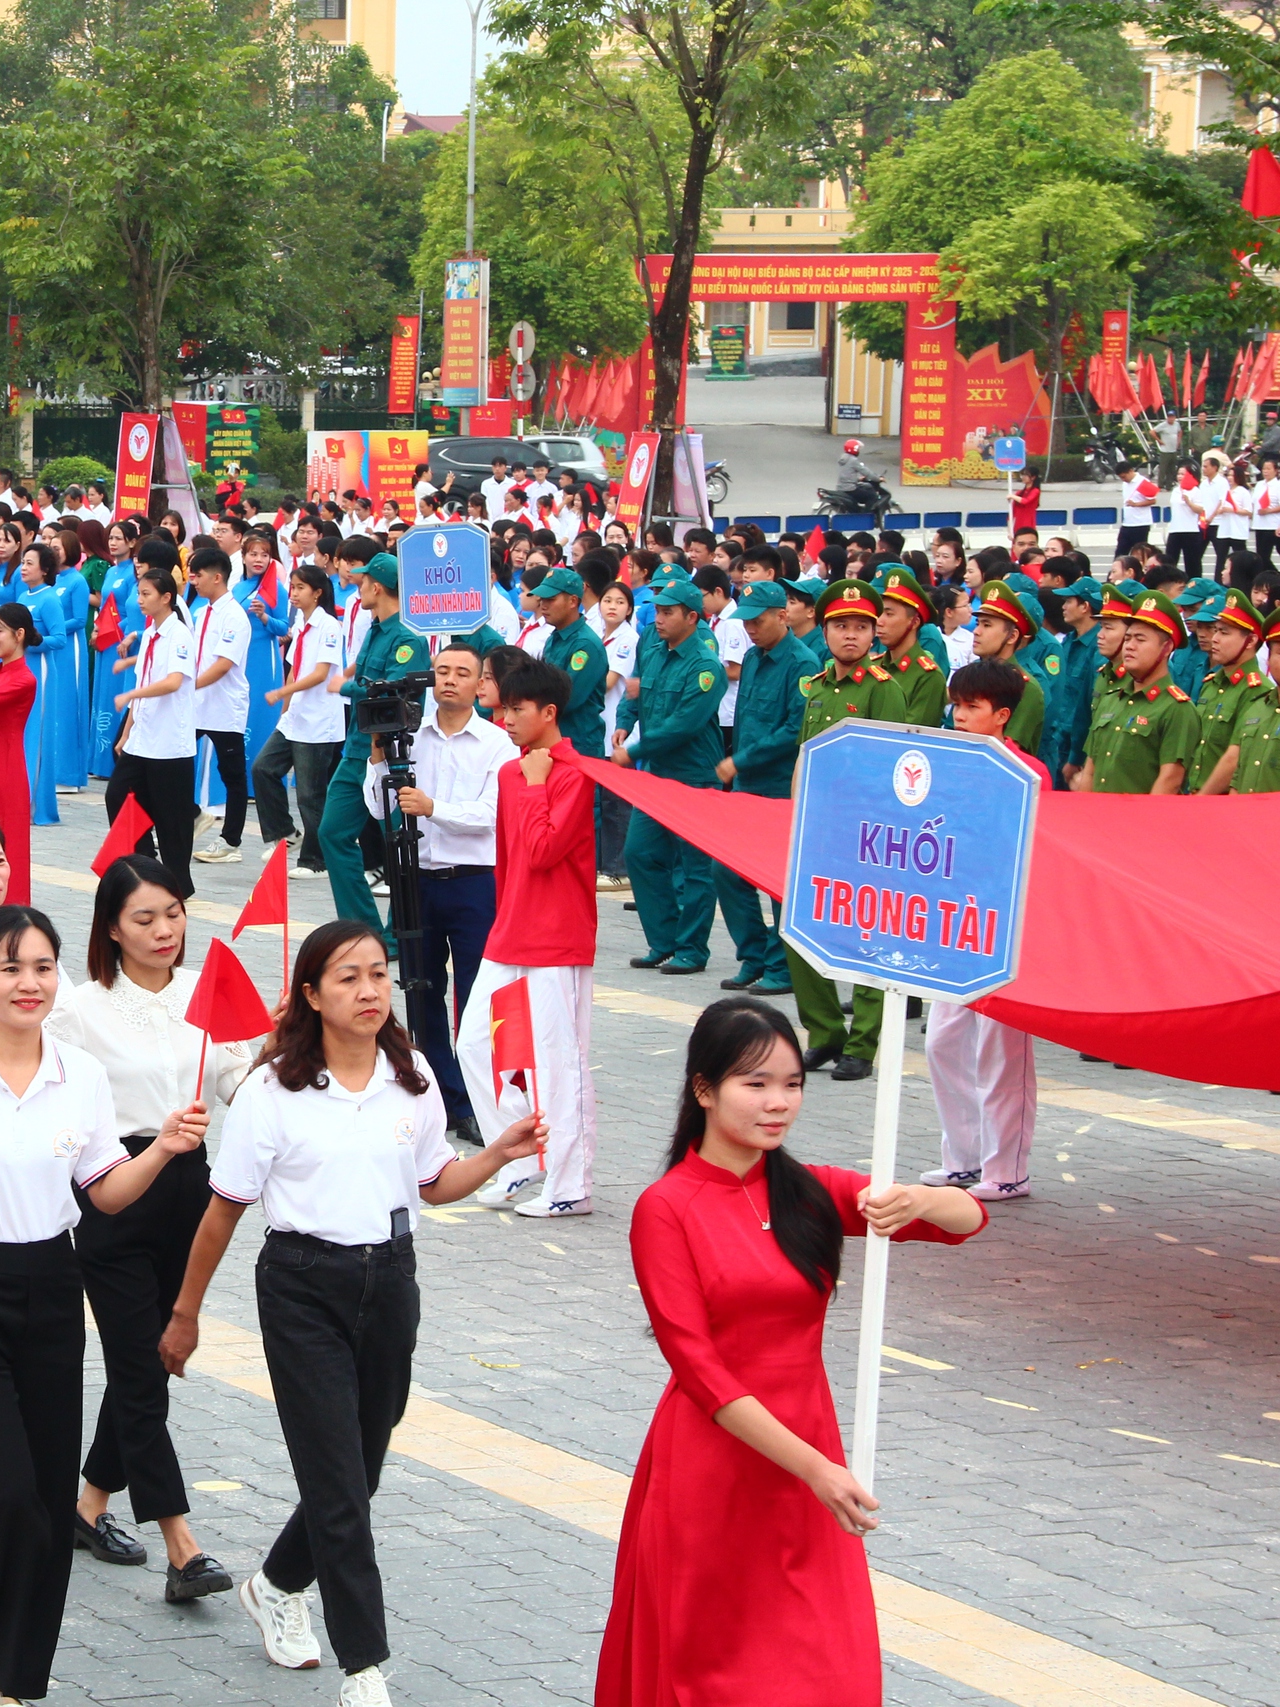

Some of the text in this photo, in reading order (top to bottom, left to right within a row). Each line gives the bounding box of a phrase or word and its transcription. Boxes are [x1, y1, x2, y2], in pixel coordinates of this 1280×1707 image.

[711, 266, 725, 280] ĐẠI
[727, 265, 741, 280] HỘI
[743, 266, 756, 280] ĐẠI
[758, 264, 776, 278] BIỂU
[778, 264, 801, 278] ĐẢNG
[802, 265, 814, 280] BỘ
[815, 264, 831, 278] CÁC
[833, 264, 849, 278] CẤP
[852, 265, 878, 279] NHIỆM
[892, 266, 912, 277] 2025
[692, 283, 706, 296] ĐẠI
[708, 280, 726, 294] BIỂU
[728, 281, 749, 294] TOÀN
[751, 281, 772, 295] QUỐC
[774, 281, 790, 294] LẦN
[792, 282, 807, 294] THỨ
[809, 284, 822, 294] XIV
[824, 281, 840, 294] CỦA
[841, 281, 864, 294] ĐẢNG
[866, 282, 888, 296] CỘNG
[890, 280, 907, 294] SẢN
[909, 281, 926, 295] VIỆT
[920, 341, 940, 354] TẤT CẢ
[911, 360, 947, 372] VÌ MỤC TIÊU
[914, 376, 928, 387] DÂN
[987, 378, 1004, 386] HỘI
[966, 388, 1008, 401] XIV
[914, 408, 941, 419] DÂN CHỦ
[909, 424, 944, 436] CÔNG BẰNG
[911, 442, 941, 453] VĂN MINH
[125, 472, 147, 488] ĐOÀN KẾT
[424, 557, 461, 586] KHỐI
[409, 587, 482, 615] CÔNG AN NHÂN DÂN
[858, 814, 956, 879] KHỐI
[811, 875, 998, 957] TRỌNG TÀI
